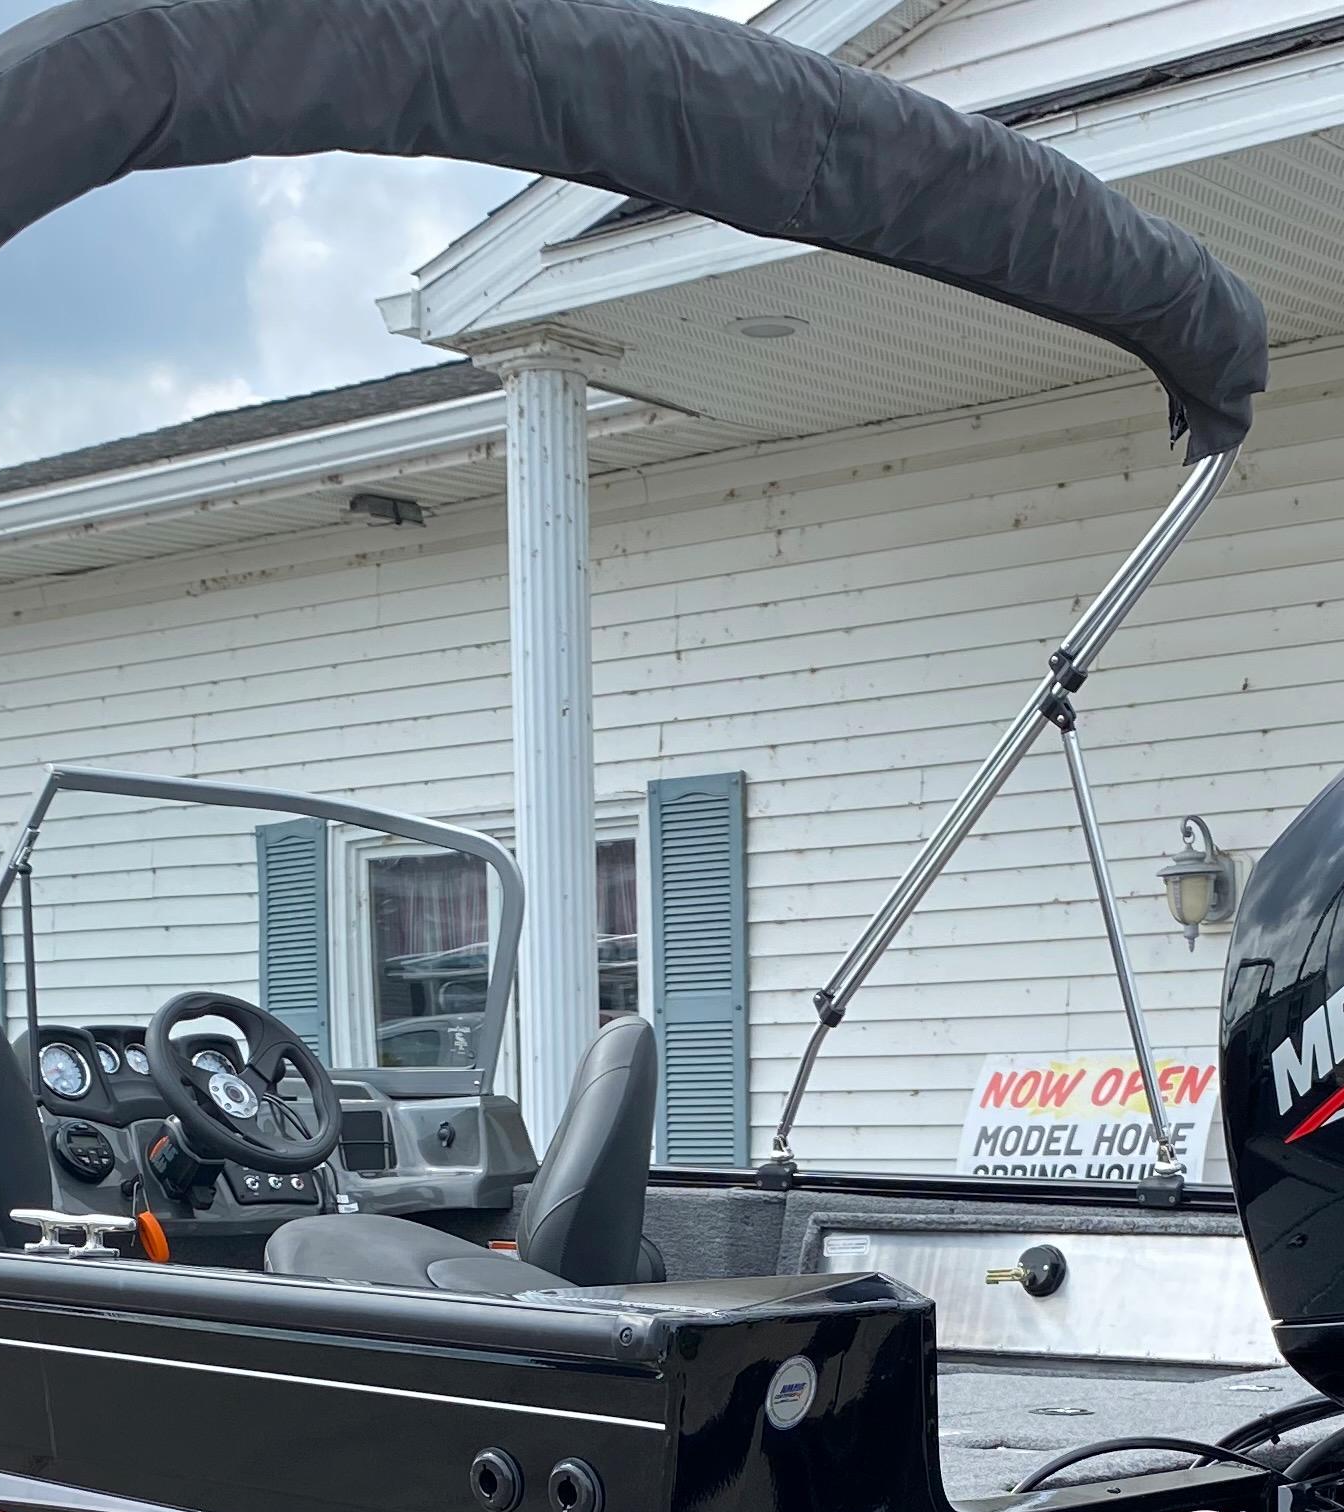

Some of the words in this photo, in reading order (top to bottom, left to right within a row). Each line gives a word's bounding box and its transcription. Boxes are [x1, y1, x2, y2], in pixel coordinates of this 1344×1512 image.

[979, 1067, 1087, 1109] NOW
[1091, 1065, 1216, 1107] OPEN
[973, 1123, 1084, 1157] MODEL
[1092, 1122, 1196, 1156] HOME
